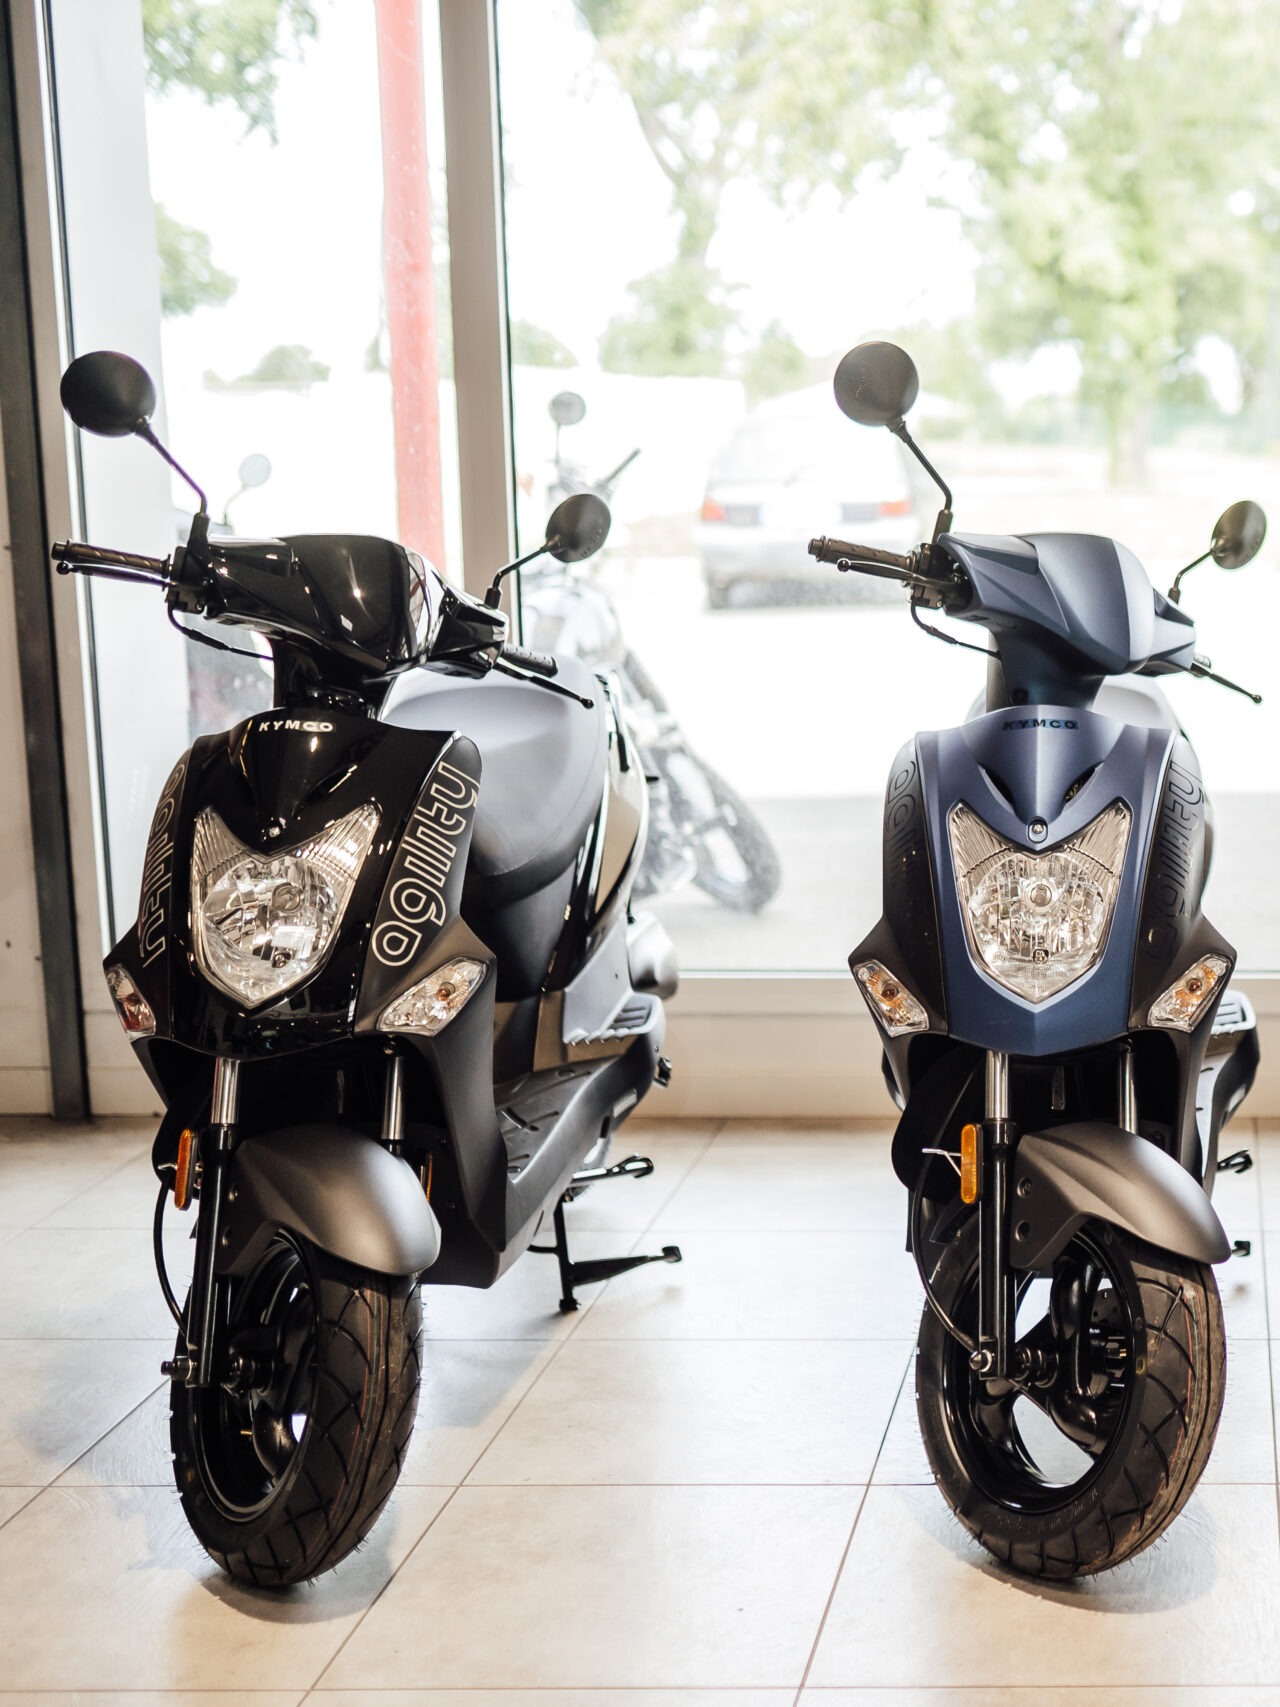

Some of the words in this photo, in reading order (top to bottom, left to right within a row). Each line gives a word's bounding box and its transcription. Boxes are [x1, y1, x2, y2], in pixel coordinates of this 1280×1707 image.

[259, 720, 333, 732] KYMCO
[1003, 719, 1076, 731] KYMCO
[371, 762, 481, 966] agility
